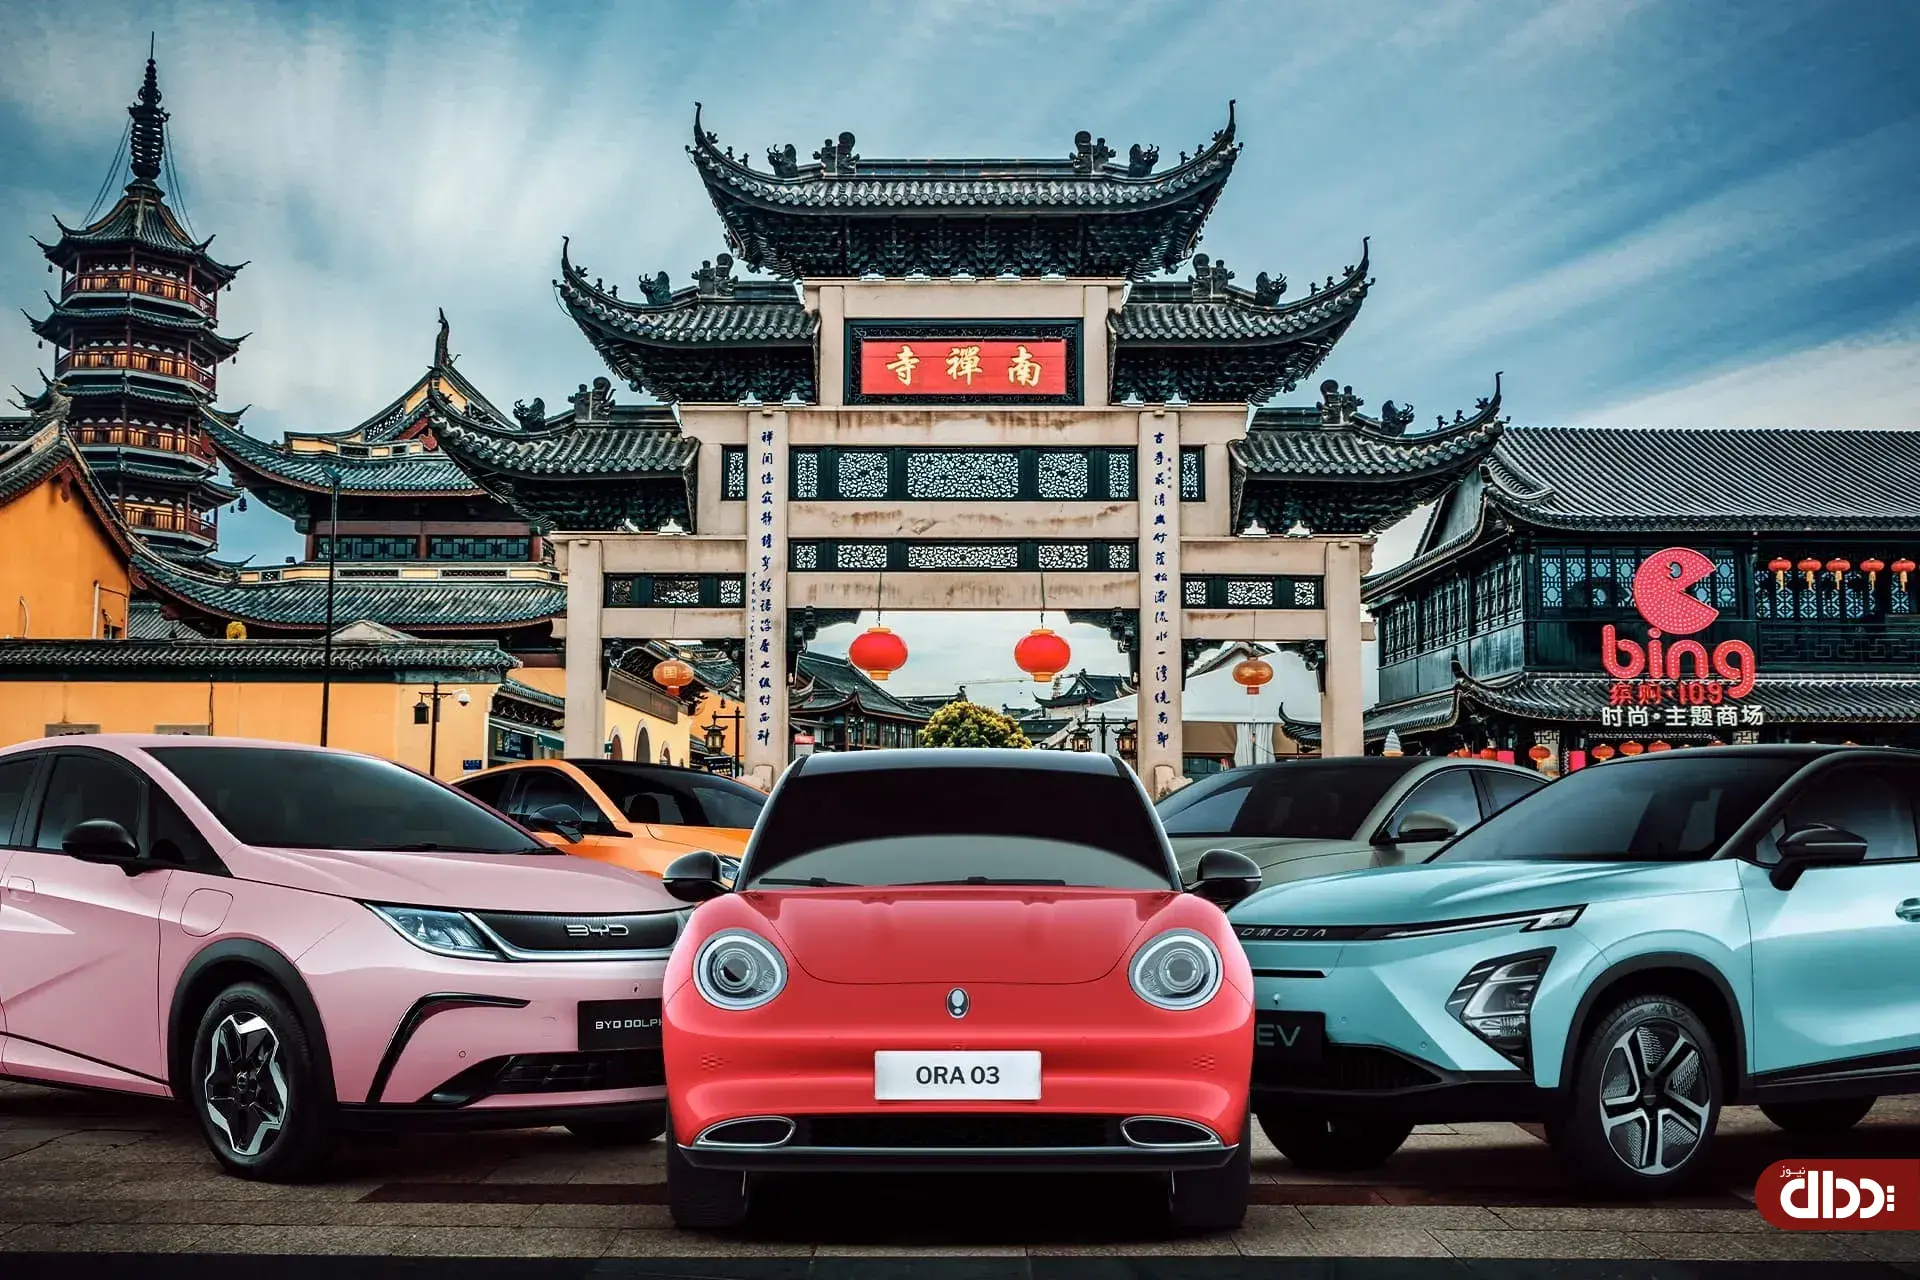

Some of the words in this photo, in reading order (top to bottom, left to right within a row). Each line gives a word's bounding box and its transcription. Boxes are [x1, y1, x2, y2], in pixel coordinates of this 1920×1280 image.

[886, 343, 1043, 388] 南禪寺
[1602, 624, 1756, 699] bing
[1601, 705, 1765, 727] 时尚·主题商场
[566, 923, 630, 937] BYD
[595, 1020, 622, 1030] BYD
[1256, 1023, 1302, 1047] EV
[916, 1066, 966, 1085] ORA
[970, 1066, 1000, 1085] 03
